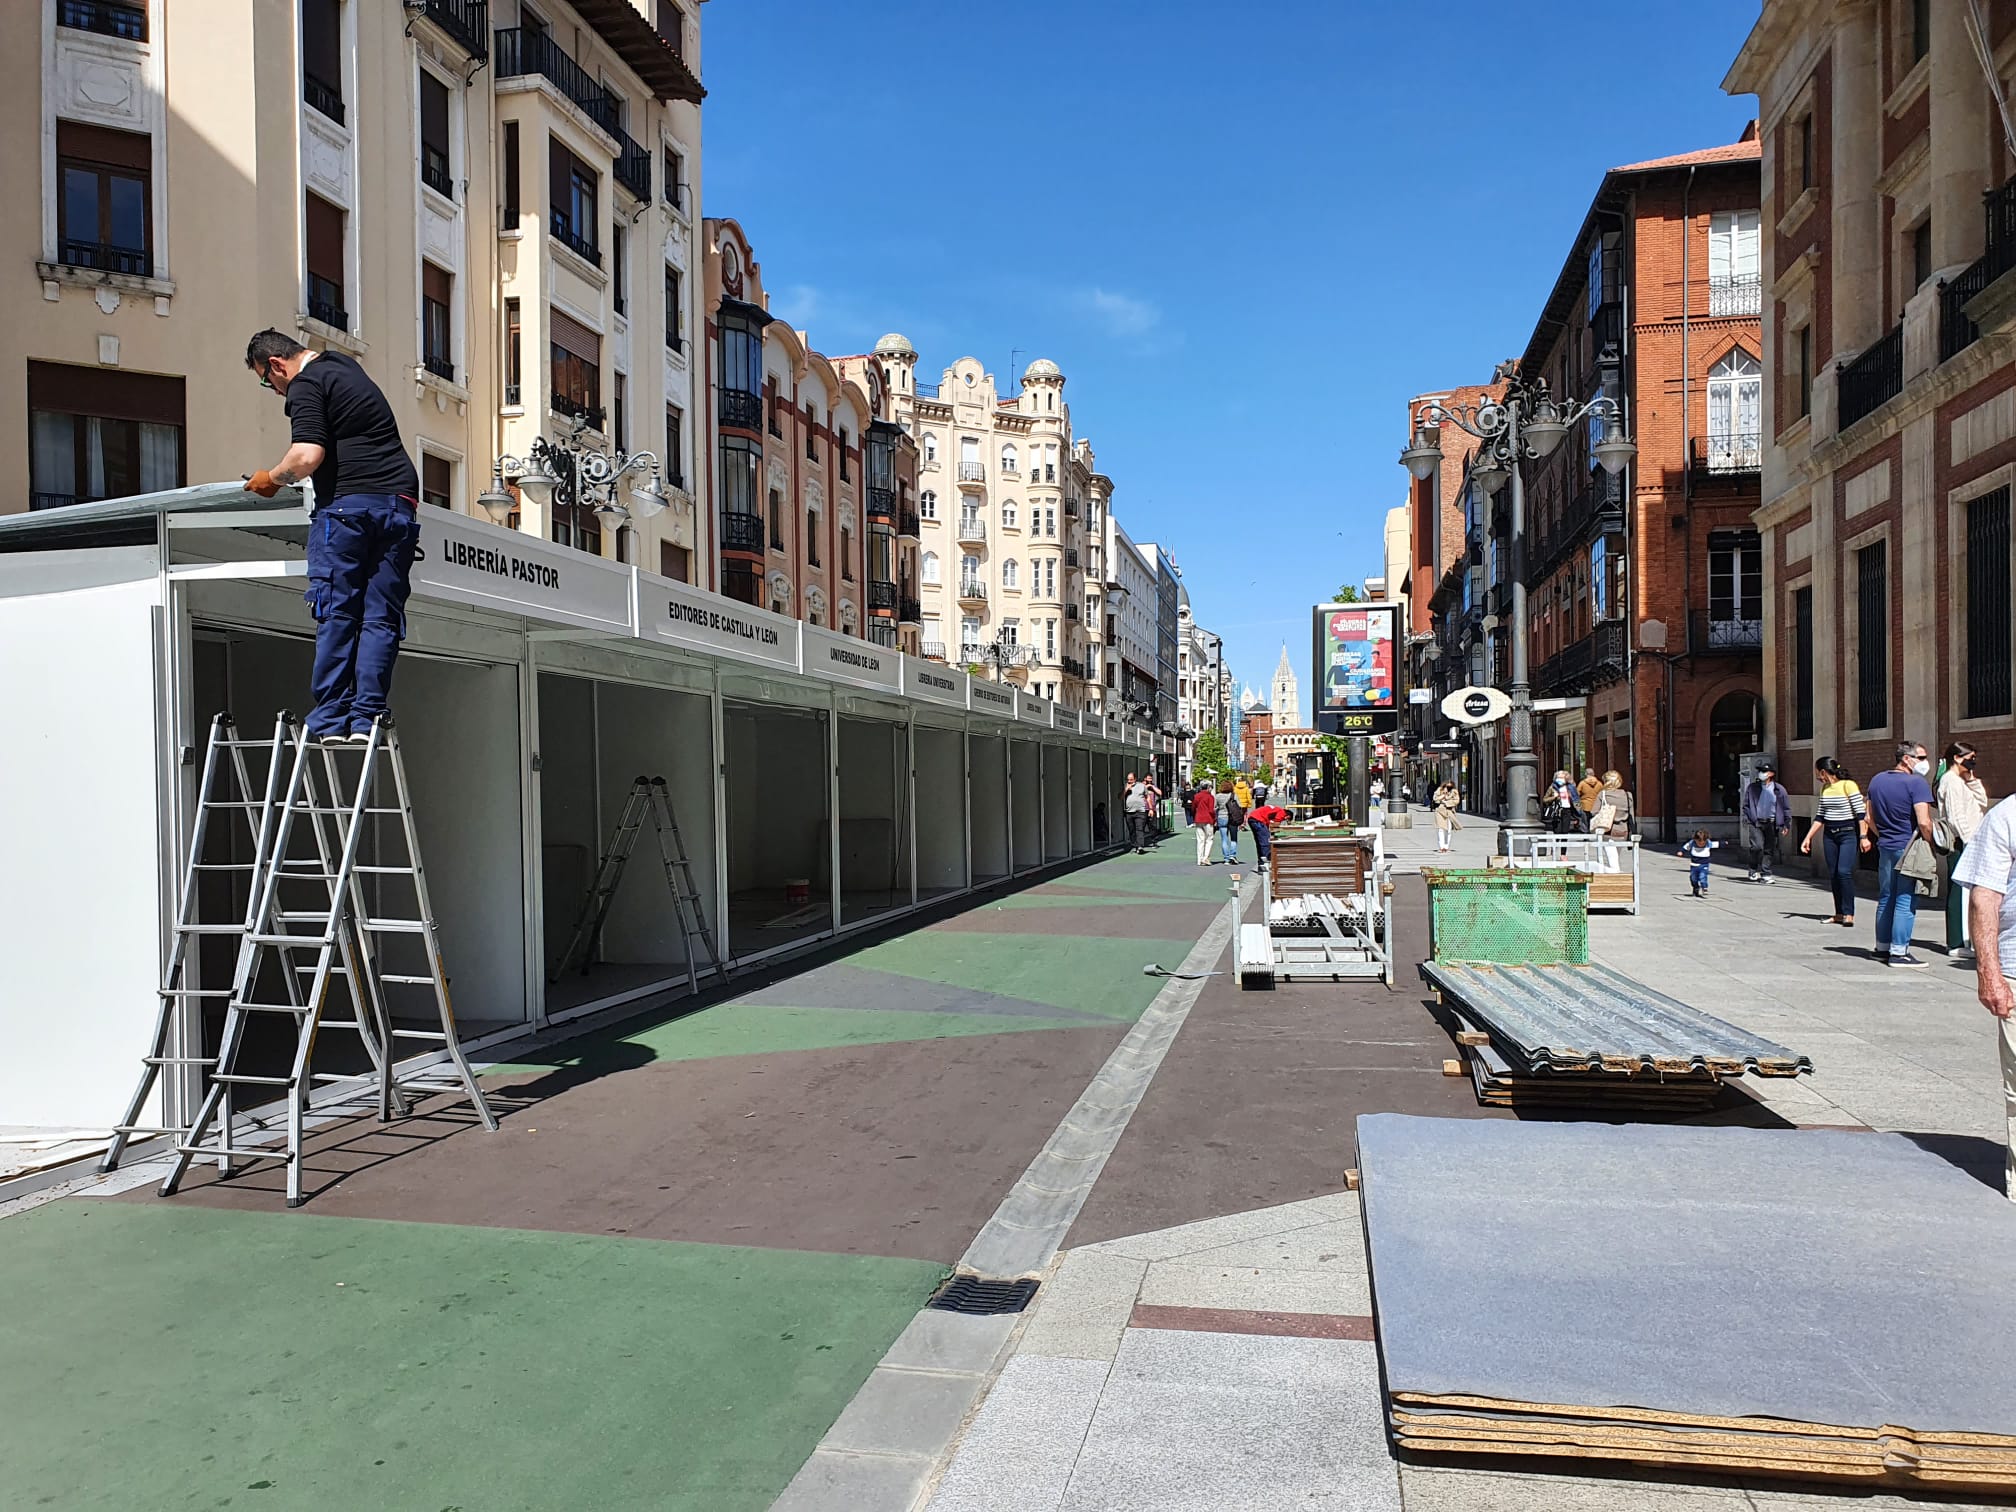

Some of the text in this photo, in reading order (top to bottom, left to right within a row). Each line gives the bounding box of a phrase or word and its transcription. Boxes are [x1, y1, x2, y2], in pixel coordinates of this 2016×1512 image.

[444, 539, 559, 589] LIBRERÍA PASTOR
[669, 601, 778, 646] EDITORES DE CASTILLA Y LEÓN
[830, 647, 880, 672] UNIVERSIDAD DE LEÓN
[1344, 716, 1373, 727] 26°C
